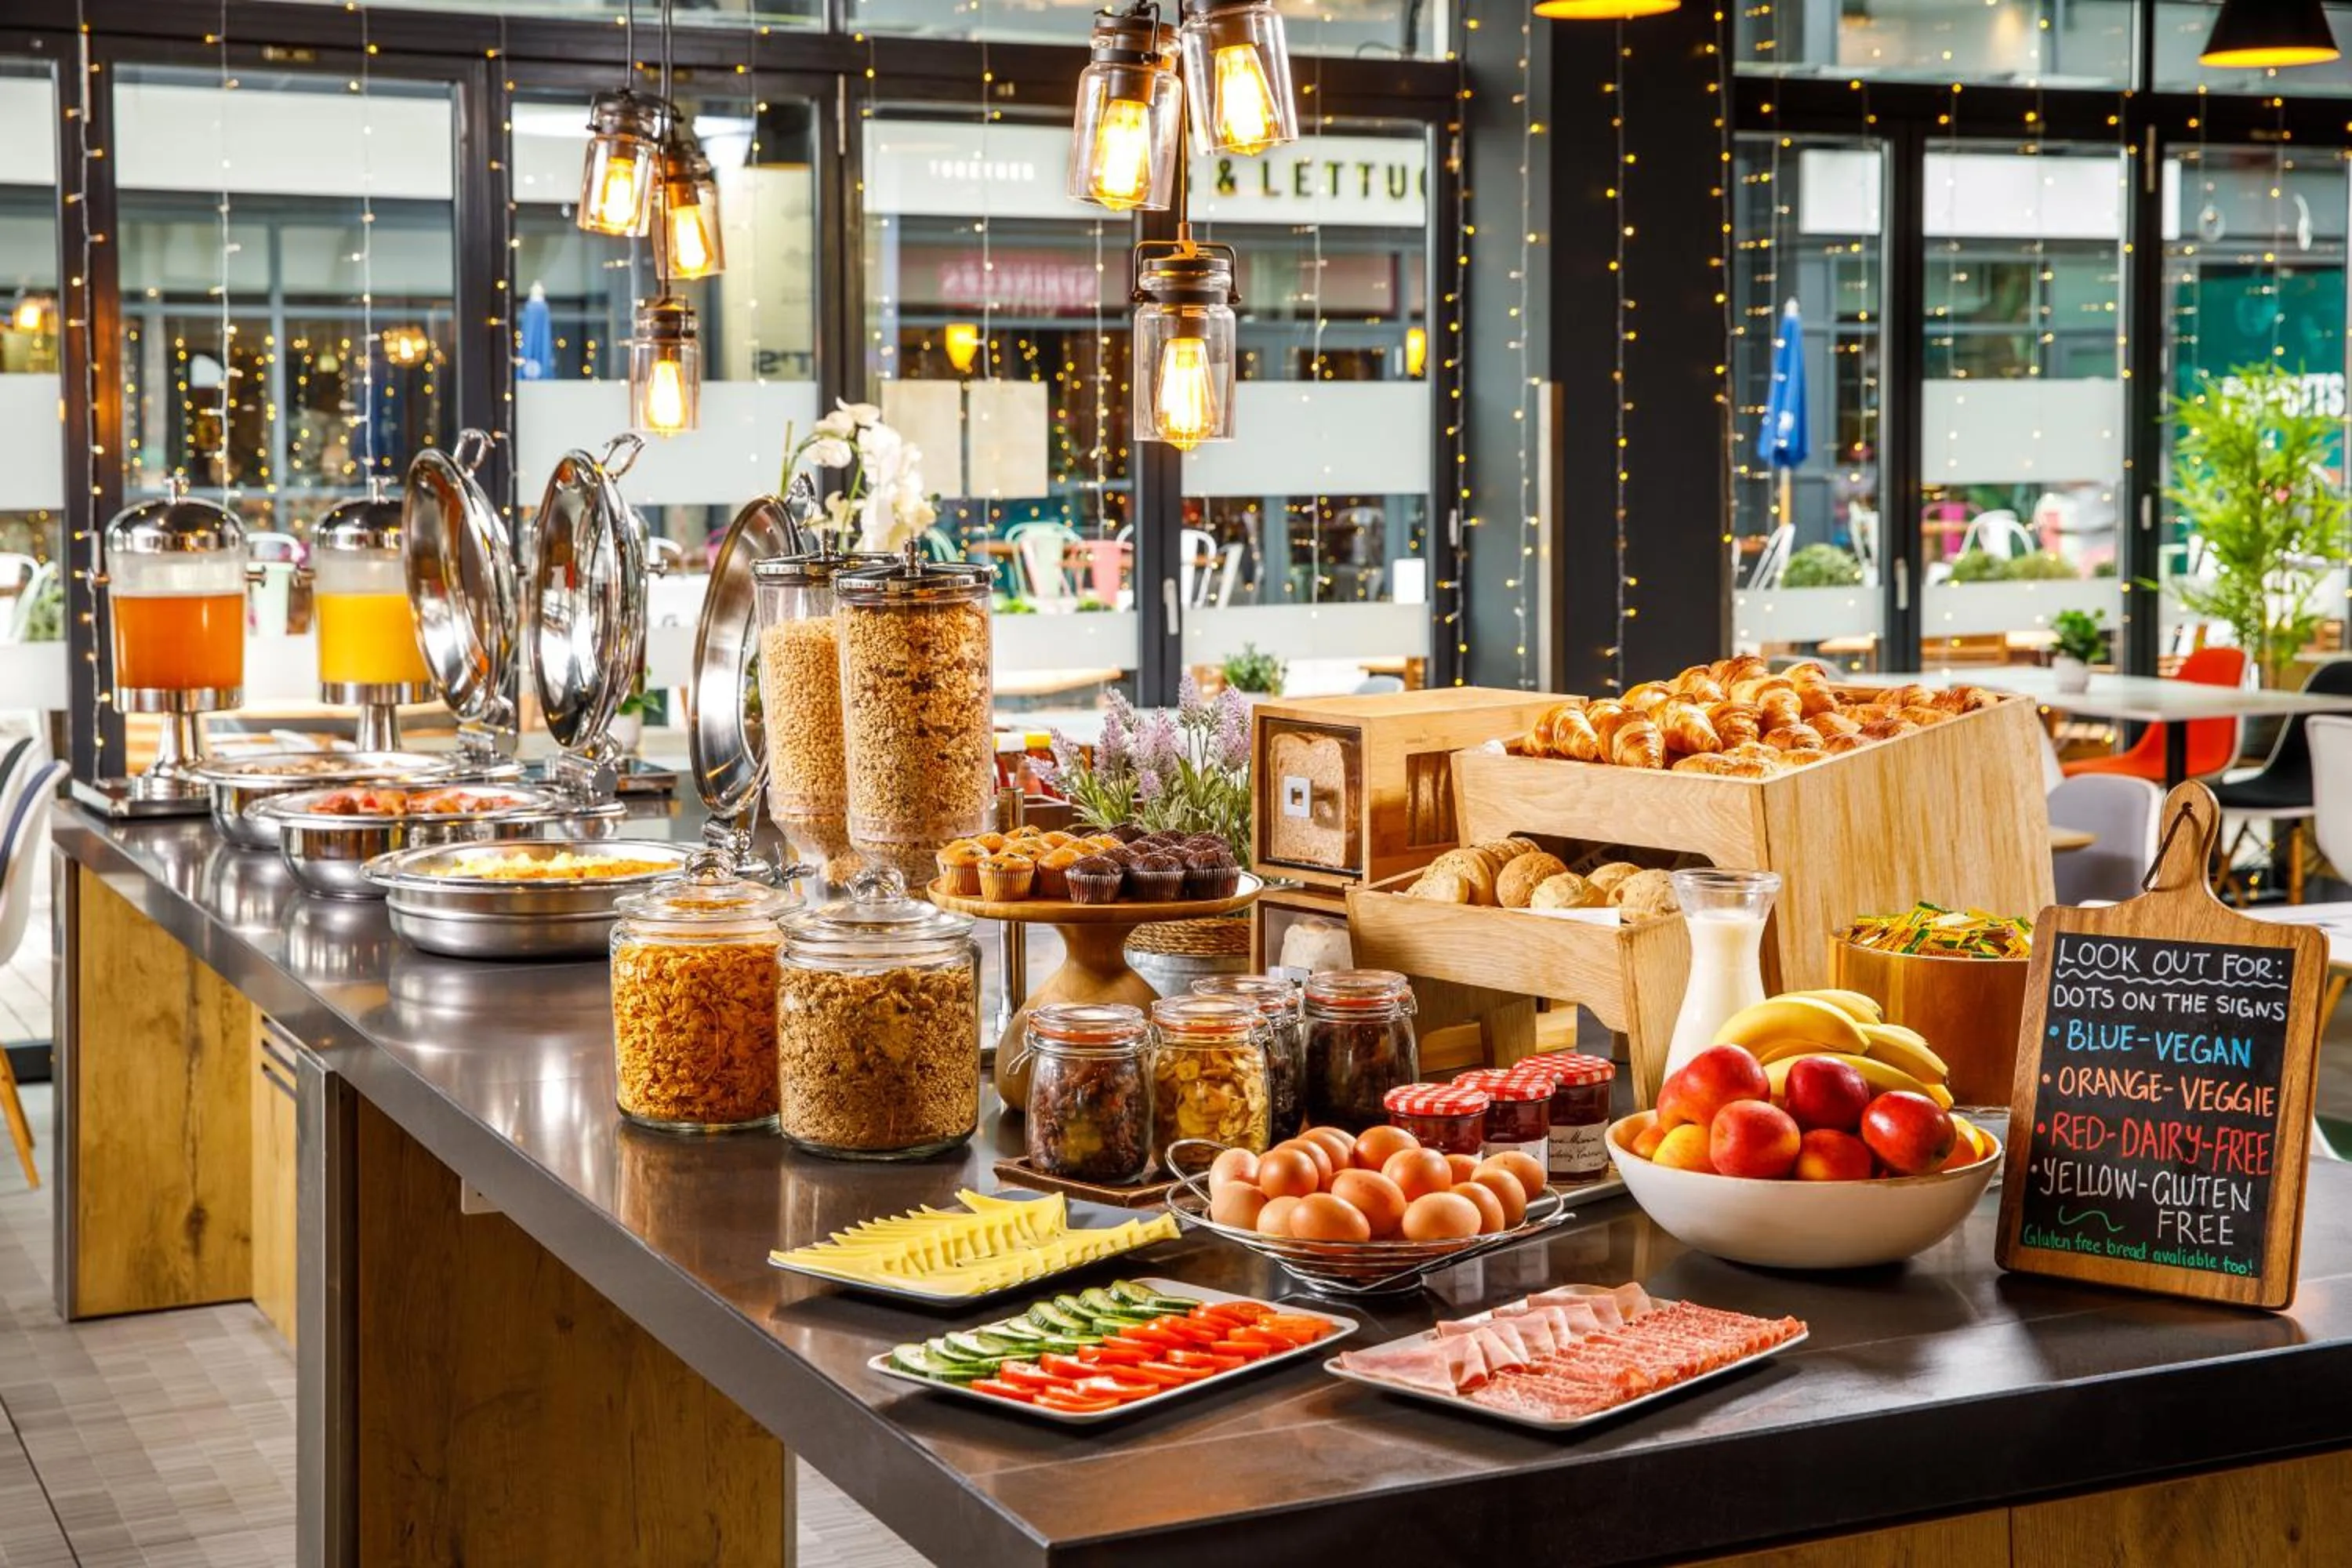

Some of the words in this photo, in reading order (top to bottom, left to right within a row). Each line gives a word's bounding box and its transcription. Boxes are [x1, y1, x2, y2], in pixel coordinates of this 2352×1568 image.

[1217, 158, 1236, 193] &
[2058, 938, 2141, 974] LOOK
[2153, 949, 2211, 977] OUT
[2222, 953, 2284, 981] FOR:
[2053, 984, 2115, 1010] DOTS
[2122, 991, 2156, 1012] ON
[2161, 992, 2209, 1014] THE
[2216, 995, 2287, 1022] SIGNS
[2074, 1231, 2101, 1252] free
[2106, 1237, 2148, 1261] bread
[2158, 1208, 2234, 1247] FREE
